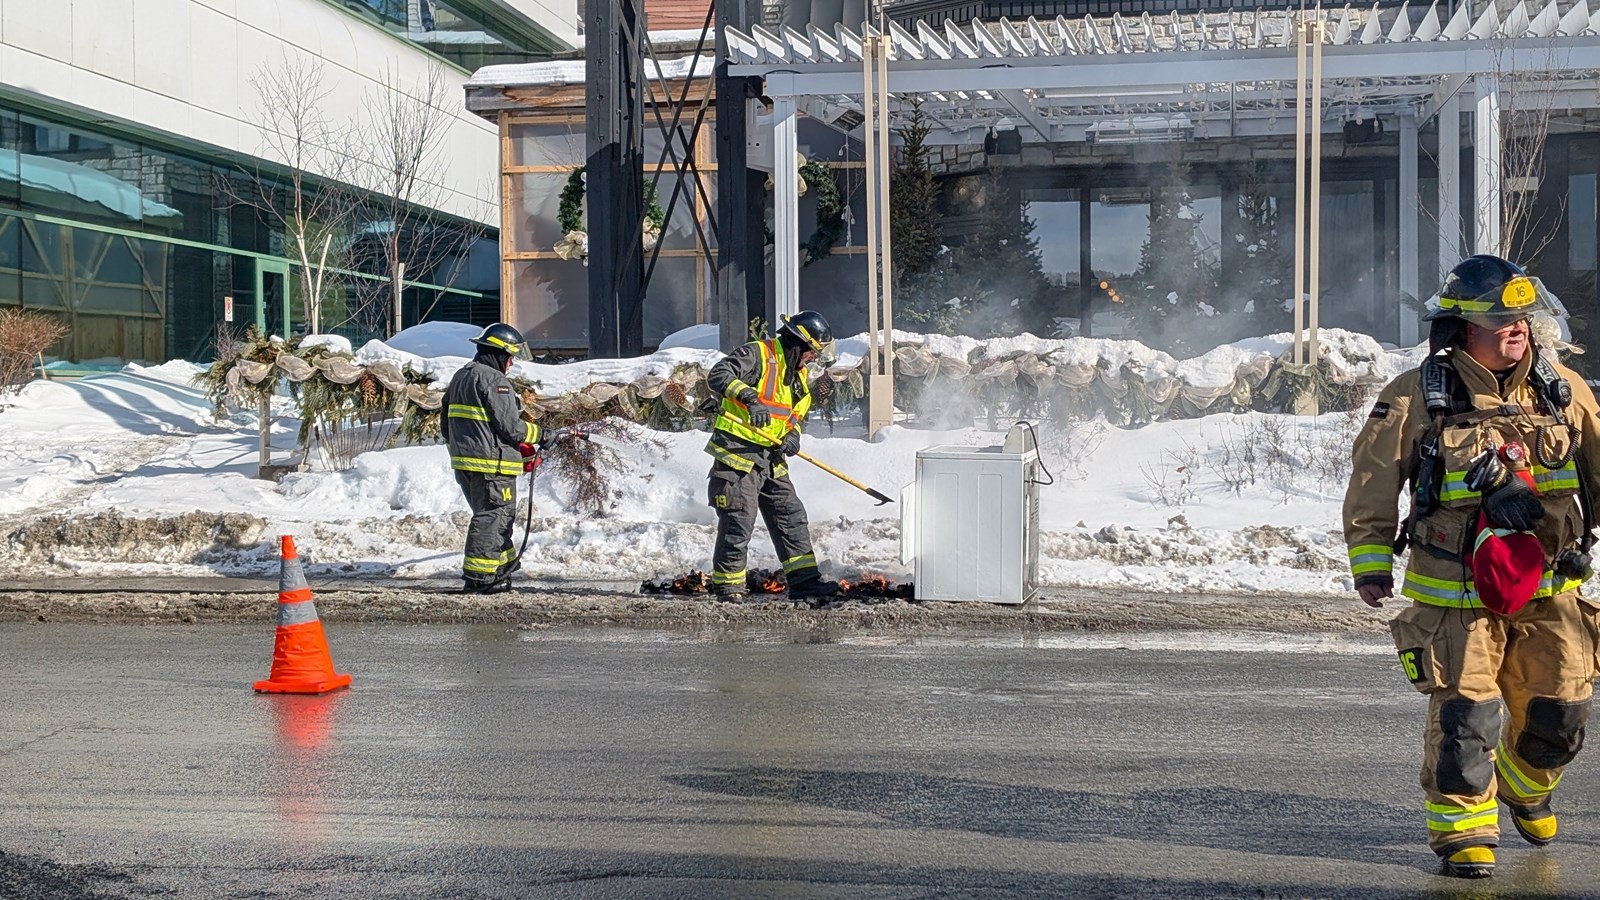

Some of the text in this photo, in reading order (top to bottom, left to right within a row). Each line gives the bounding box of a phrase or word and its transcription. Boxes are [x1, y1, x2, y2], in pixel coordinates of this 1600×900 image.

[1515, 286, 1526, 298] 16
[501, 487, 512, 501] 14
[714, 495, 727, 508] 19
[1400, 651, 1418, 680] 16
